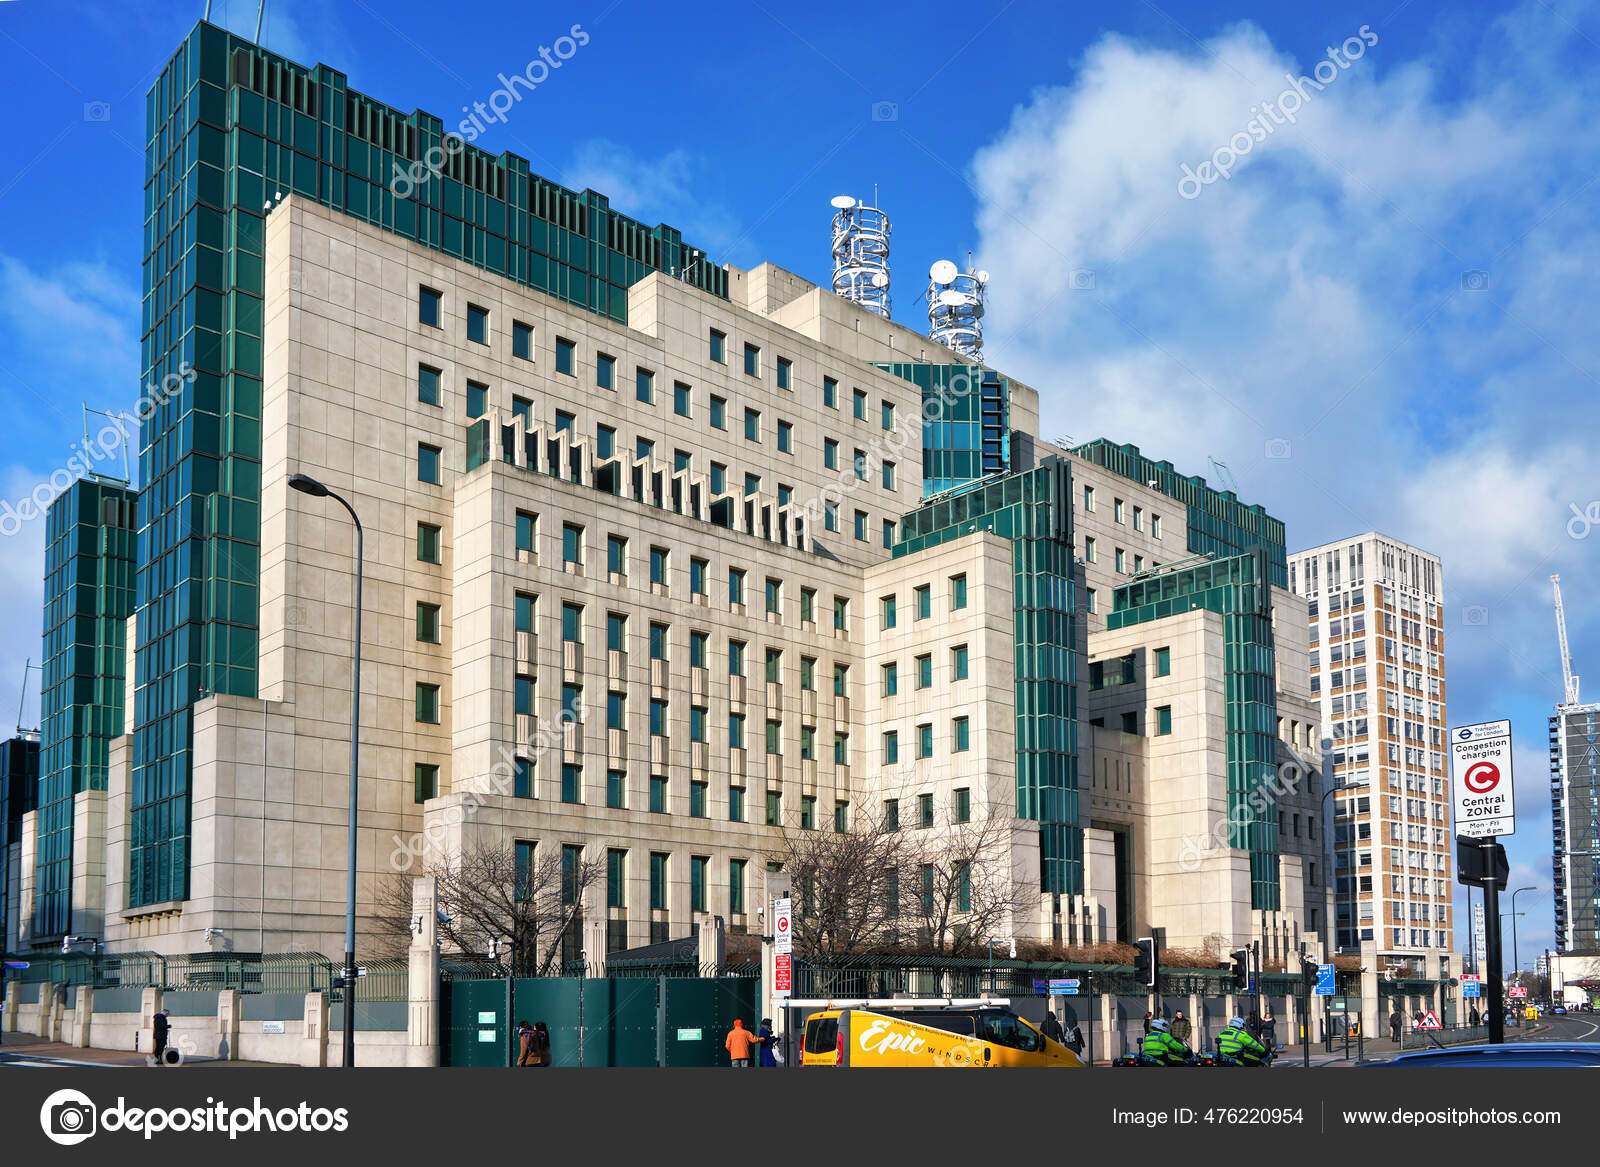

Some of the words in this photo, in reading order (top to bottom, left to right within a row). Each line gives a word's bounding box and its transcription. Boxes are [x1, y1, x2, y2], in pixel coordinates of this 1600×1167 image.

[1474, 724, 1500, 732] Transport
[1455, 740, 1507, 753] Congestion
[1461, 749, 1501, 760] charging
[1462, 794, 1505, 807] Central
[1466, 805, 1501, 817] ZONE
[859, 1019, 927, 1055] Epic
